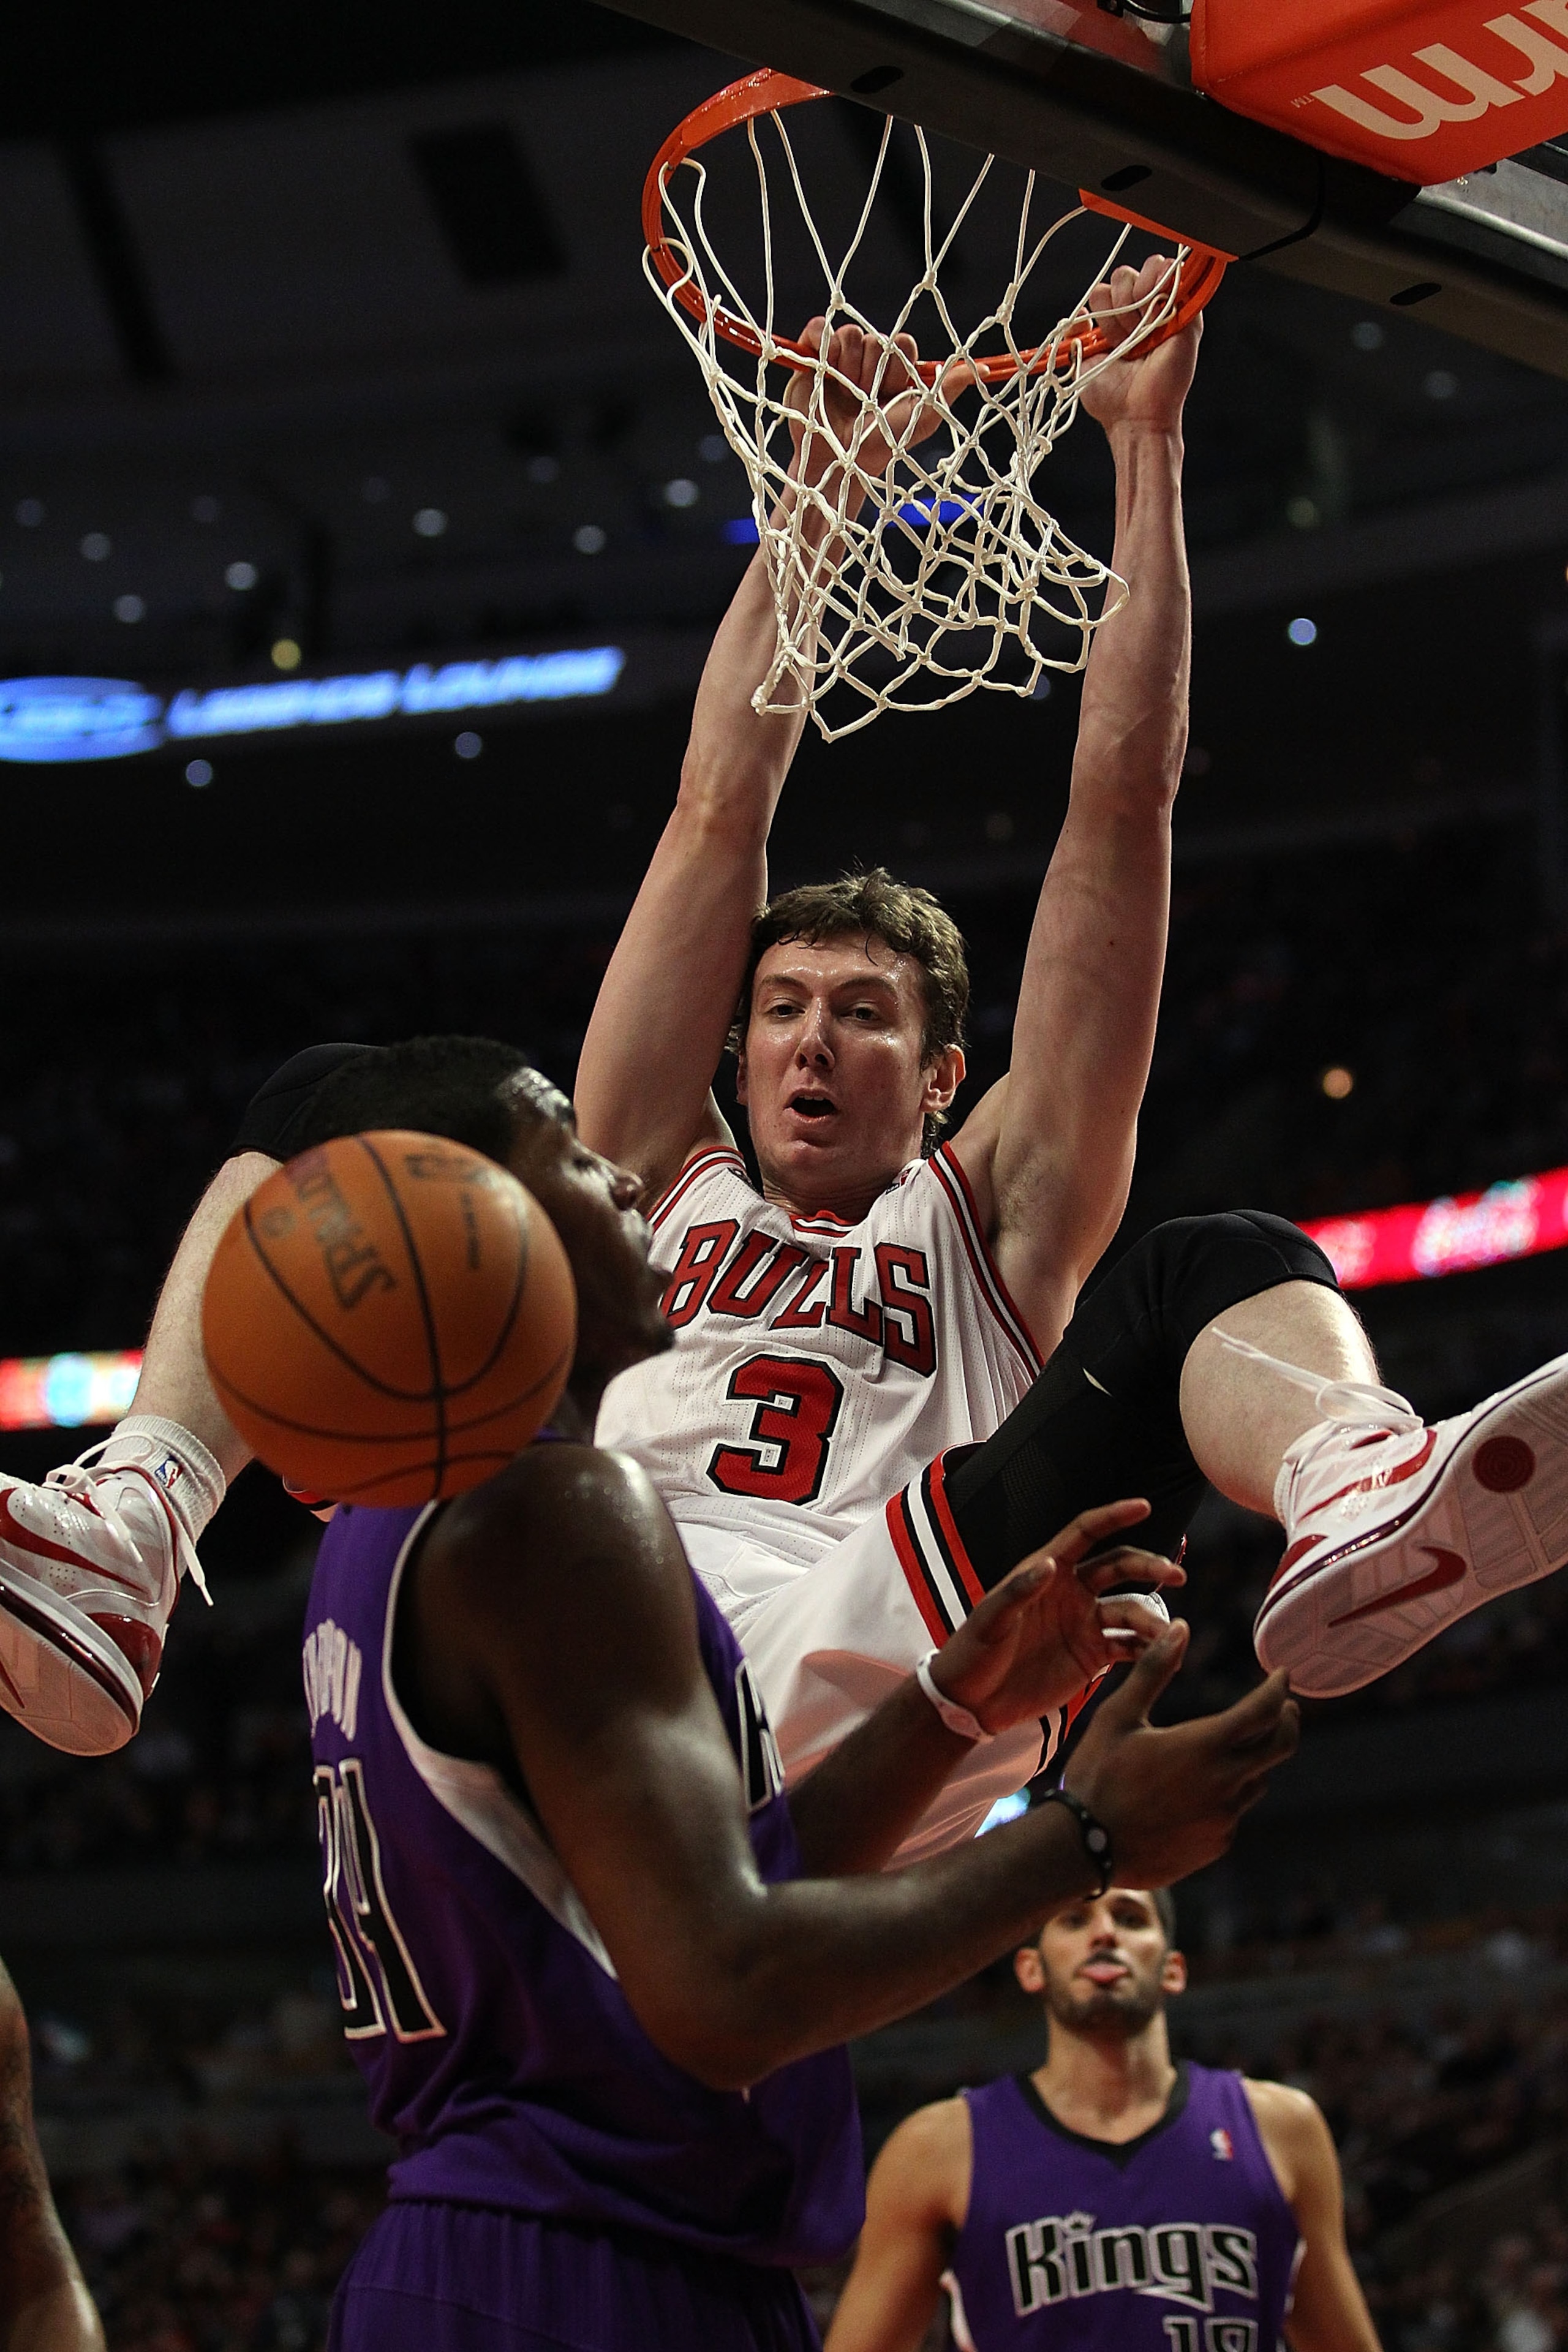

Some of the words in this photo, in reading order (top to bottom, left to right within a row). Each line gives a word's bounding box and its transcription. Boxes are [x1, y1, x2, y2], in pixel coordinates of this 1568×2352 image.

[1310, 0, 1568, 140] rm
[288, 1150, 397, 1311] SPALD
[660, 1218, 937, 1378] BULLS
[706, 1354, 844, 1506] 3
[1005, 2209, 1260, 2318] Kings
